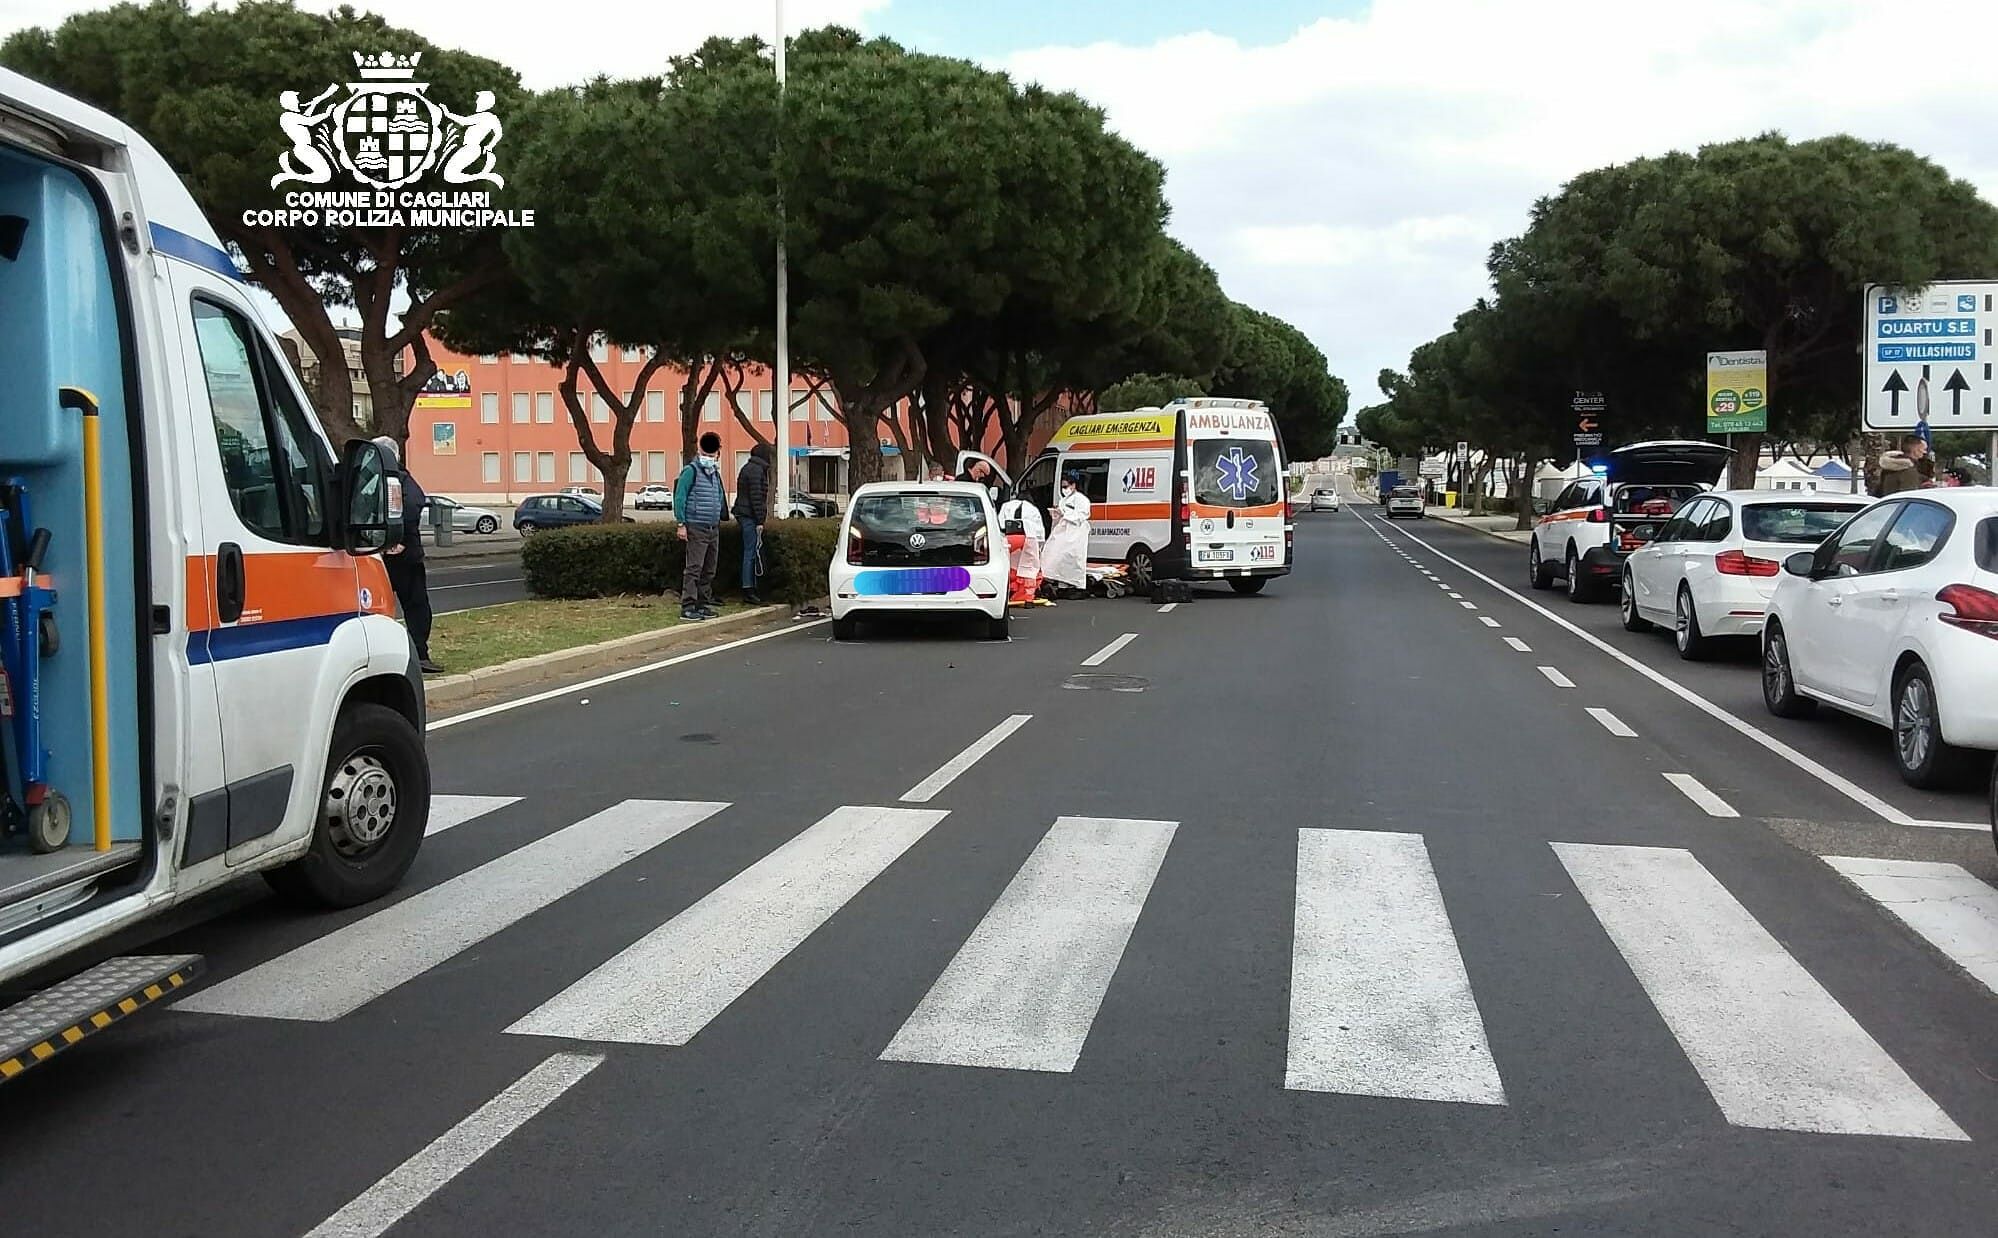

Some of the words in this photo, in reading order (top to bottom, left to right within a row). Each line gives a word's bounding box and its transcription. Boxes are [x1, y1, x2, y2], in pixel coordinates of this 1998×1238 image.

[1881, 321, 1943, 335] QUARTU
[1947, 321, 1972, 333] S.E.
[1905, 346, 1972, 358] VILLASIMIUS
[1069, 424, 1104, 436] CAGLIARI
[1105, 421, 1156, 433] EMERGENZA
[1189, 414, 1271, 431] AMBULANZA
[1134, 467, 1156, 488] 118
[1259, 546, 1275, 558] 118
